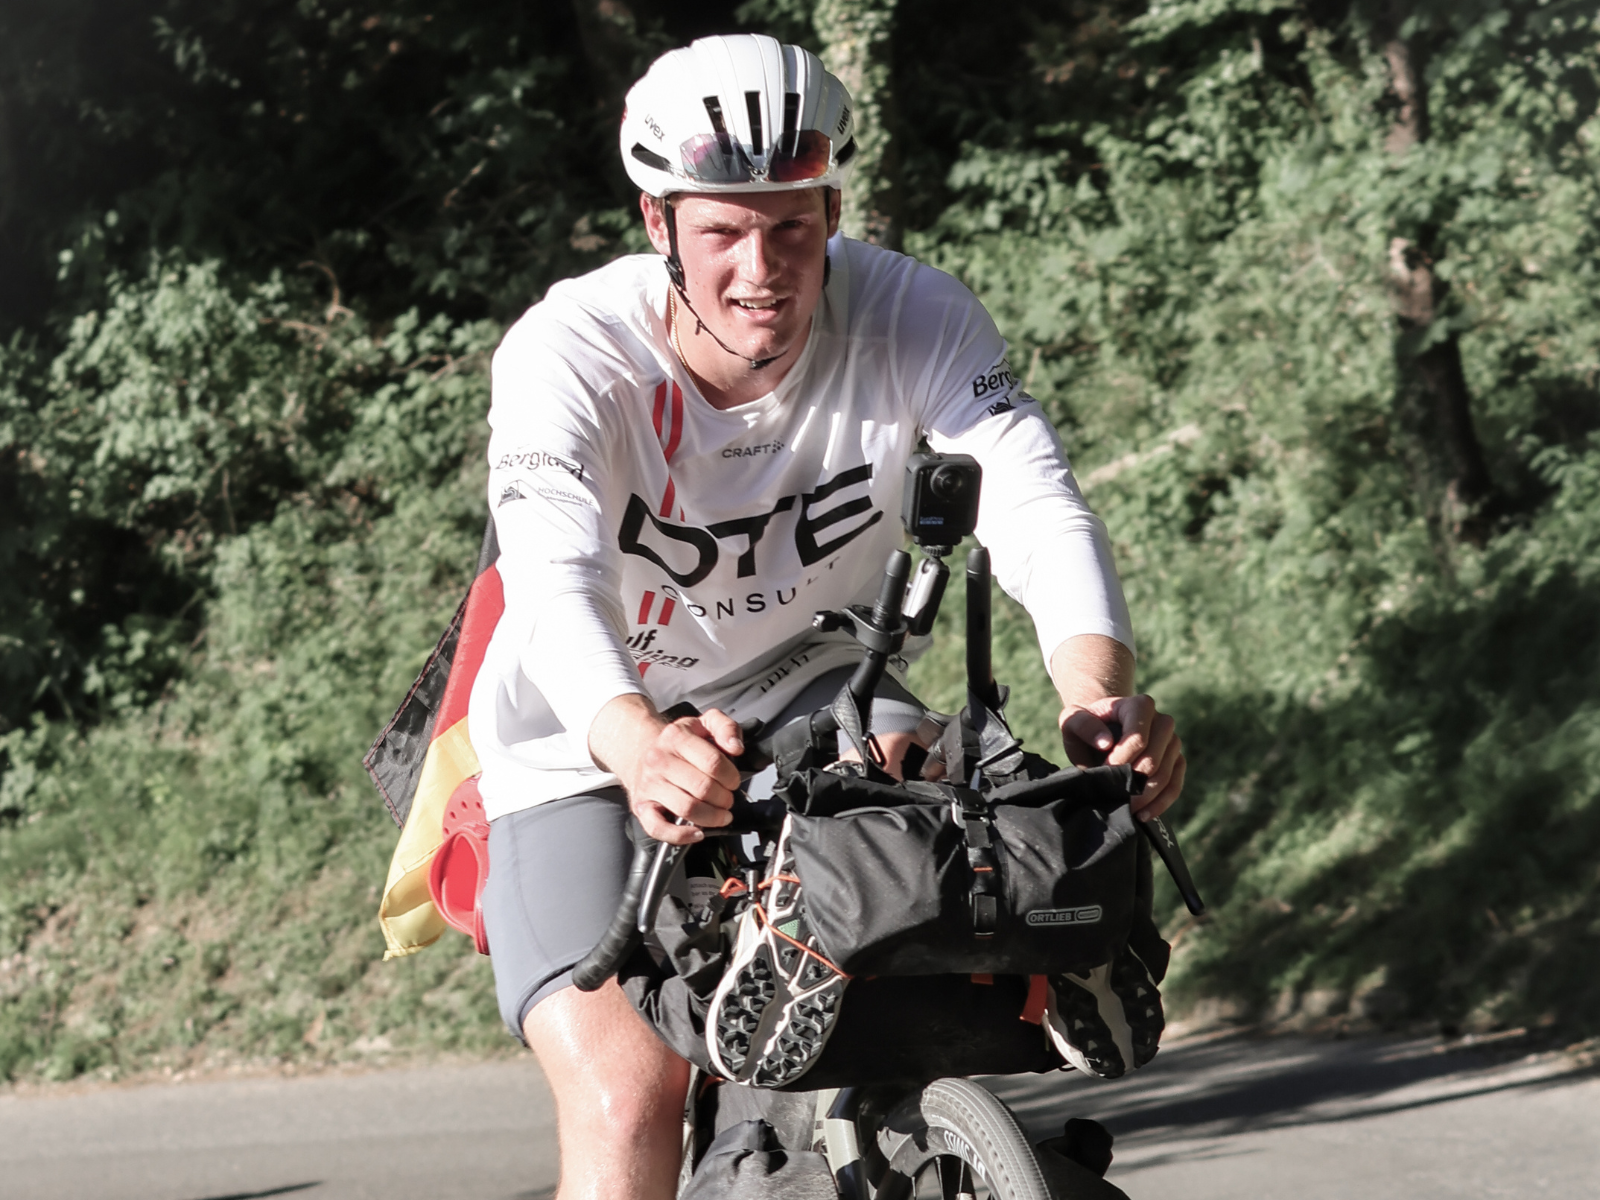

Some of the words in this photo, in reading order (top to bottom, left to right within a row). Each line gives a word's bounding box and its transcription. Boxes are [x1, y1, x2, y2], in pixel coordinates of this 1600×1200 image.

[644, 114, 665, 142] uvex
[722, 443, 771, 458] CRAFT
[538, 487, 594, 506] HOCHSCHULE
[618, 463, 884, 588] DTE
[661, 556, 841, 620] CONSULT
[1029, 911, 1072, 923] ORTLIEB
[943, 1129, 971, 1163] SWISS
